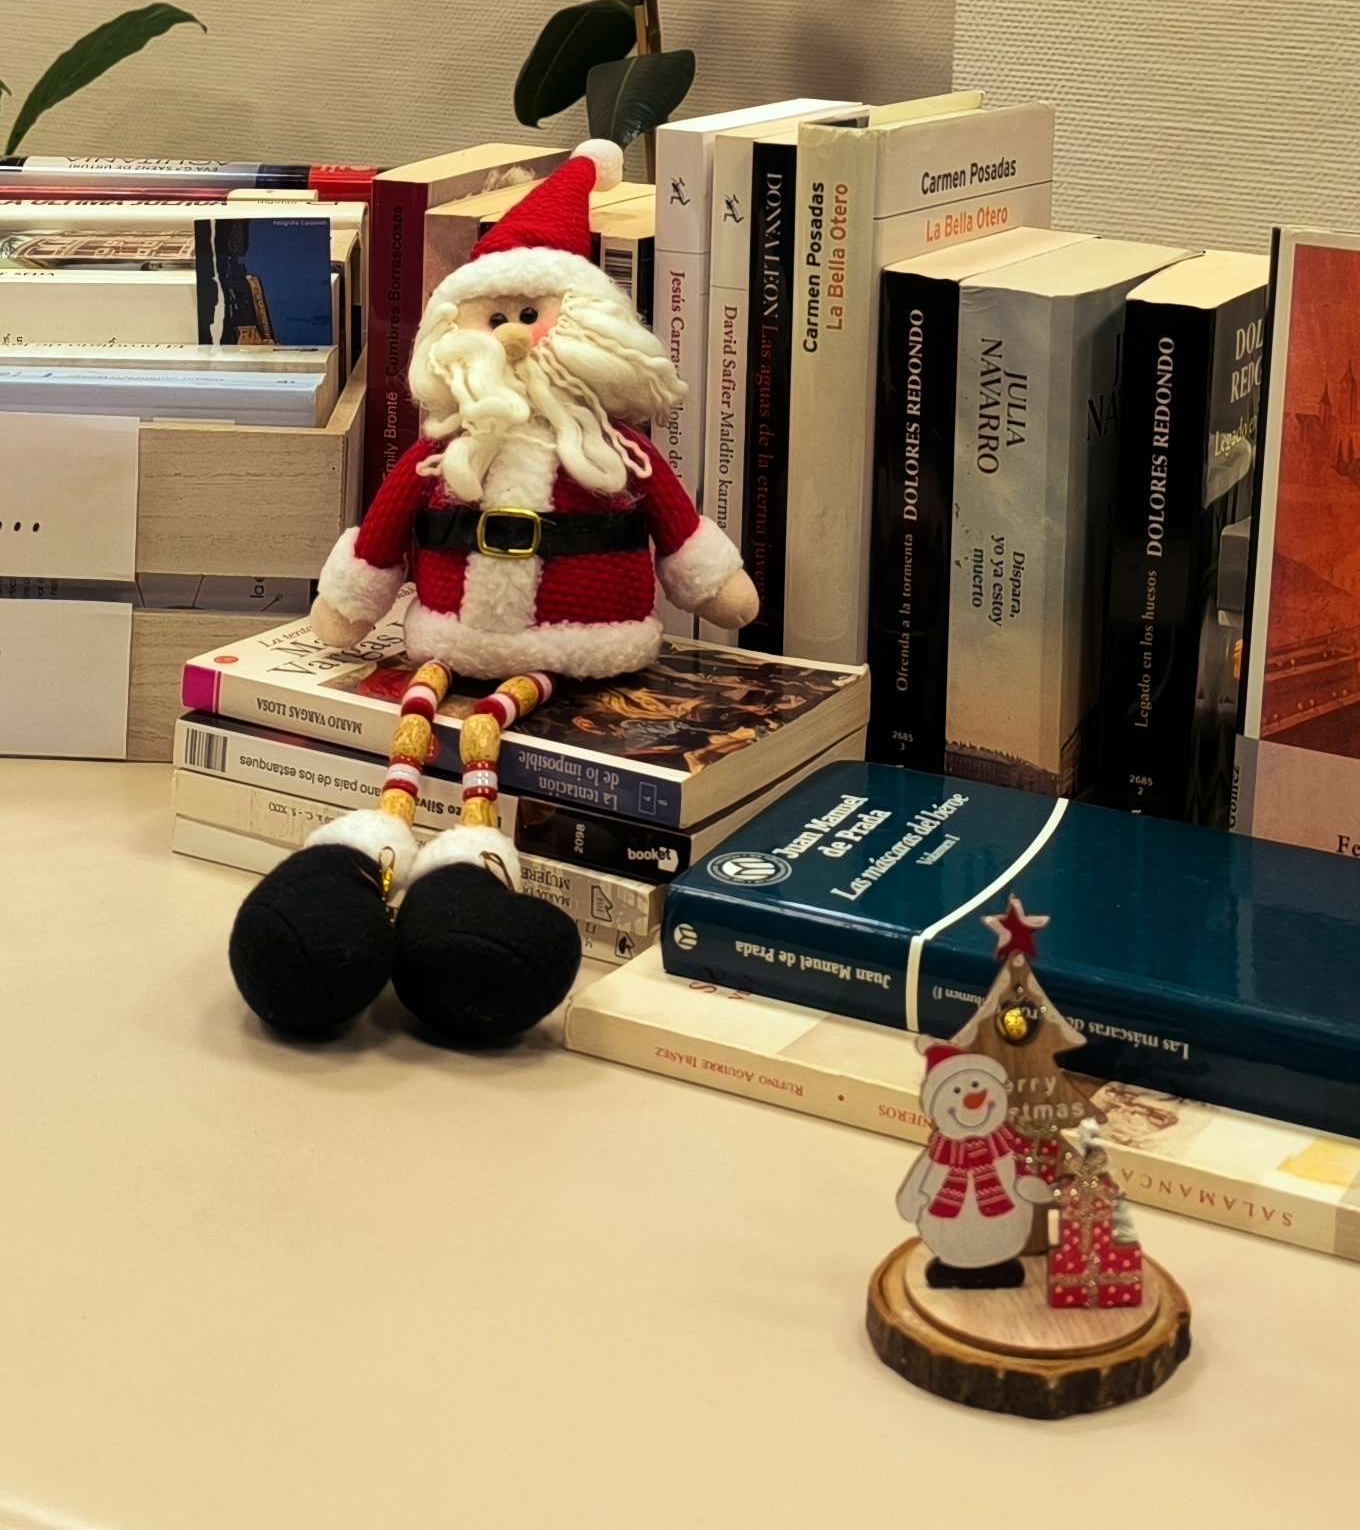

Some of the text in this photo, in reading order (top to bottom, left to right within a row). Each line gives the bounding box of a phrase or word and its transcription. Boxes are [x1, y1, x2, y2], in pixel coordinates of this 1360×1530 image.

[921, 157, 1017, 196] Carmen Posadas
[388, 205, 403, 302] Borrascosas
[926, 206, 1009, 243] La Bella Otero
[803, 181, 825, 353] Carmen Posadas
[826, 183, 848, 331] La Bella Otero
[670, 271, 685, 312] Jesús
[387, 306, 401, 377] Cumbres
[751, 173, 783, 539] DONNA LEON Las aguas eterna
[717, 305, 738, 529] David Safier Maldito karma
[903, 309, 925, 522] DOLORES REDONDO
[976, 337, 1003, 475] NAVARRO
[1003, 370, 1028, 447] JULIA
[1146, 336, 1175, 557] DOLORES REDONDO
[972, 547, 984, 608] muerto
[988, 534, 1005, 627] yo ya estoy
[1010, 550, 1026, 619] Dispara,
[896, 533, 913, 691] Ofrenda la tormenta
[266, 630, 405, 677] Vargas
[1134, 569, 1158, 728] Legado en los huesos
[256, 697, 362, 735] MARIO VARGAS LLOSA
[892, 731, 913, 742] 2685
[239, 755, 358, 793] país de los estanques
[518, 750, 620, 792] de lo imposible
[538, 776, 620, 811] La tentación
[1128, 774, 1153, 786] 2685
[574, 823, 585, 854] 2098
[627, 845, 673, 864] booket
[772, 794, 870, 859] Juan Manuel
[817, 809, 893, 859] de Prada
[830, 792, 970, 902] Las máscaras del héroe
[734, 940, 892, 989] Juan Manuel de Prada
[1087, 1018, 1190, 1060] Las máscaras
[702, 1056, 805, 1097] RUFINO AGUIRRE
[1121, 1167, 1294, 1229] SALAMANCA
